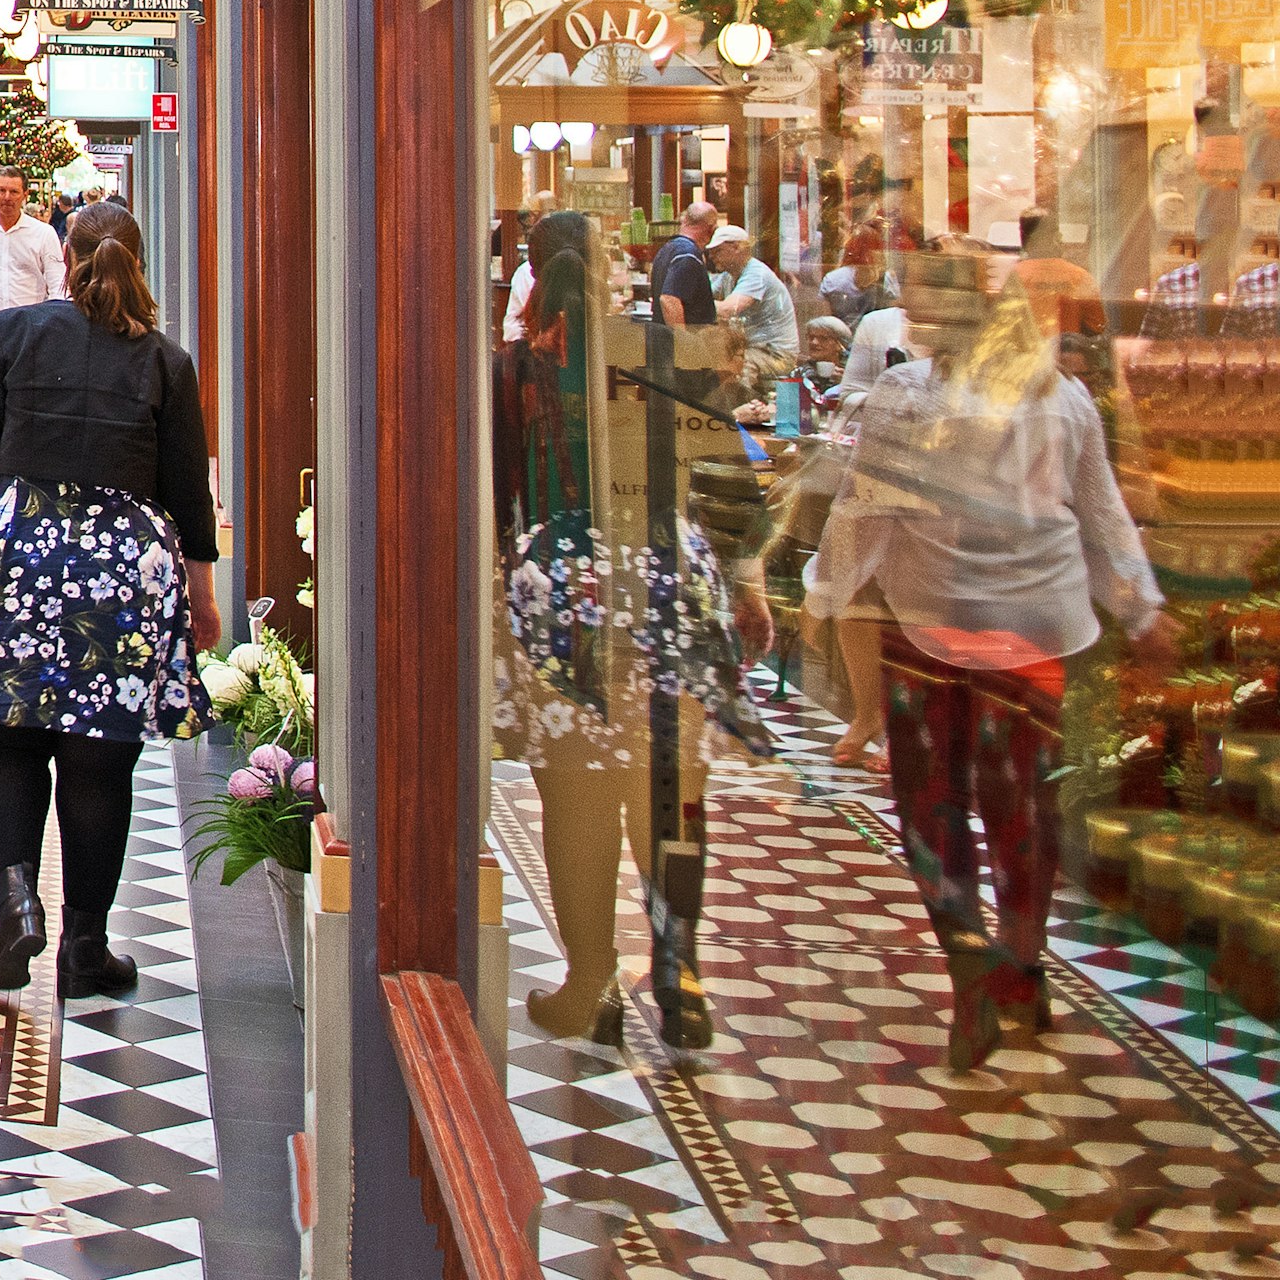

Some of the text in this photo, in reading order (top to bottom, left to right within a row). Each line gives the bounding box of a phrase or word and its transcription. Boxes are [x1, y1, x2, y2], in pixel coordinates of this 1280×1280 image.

[46, 43, 62, 55] ON
[63, 44, 84, 55] THE
[85, 45, 112, 57] SPOT
[123, 46, 165, 58] REPAIRS
[89, 58, 149, 91] Lift
